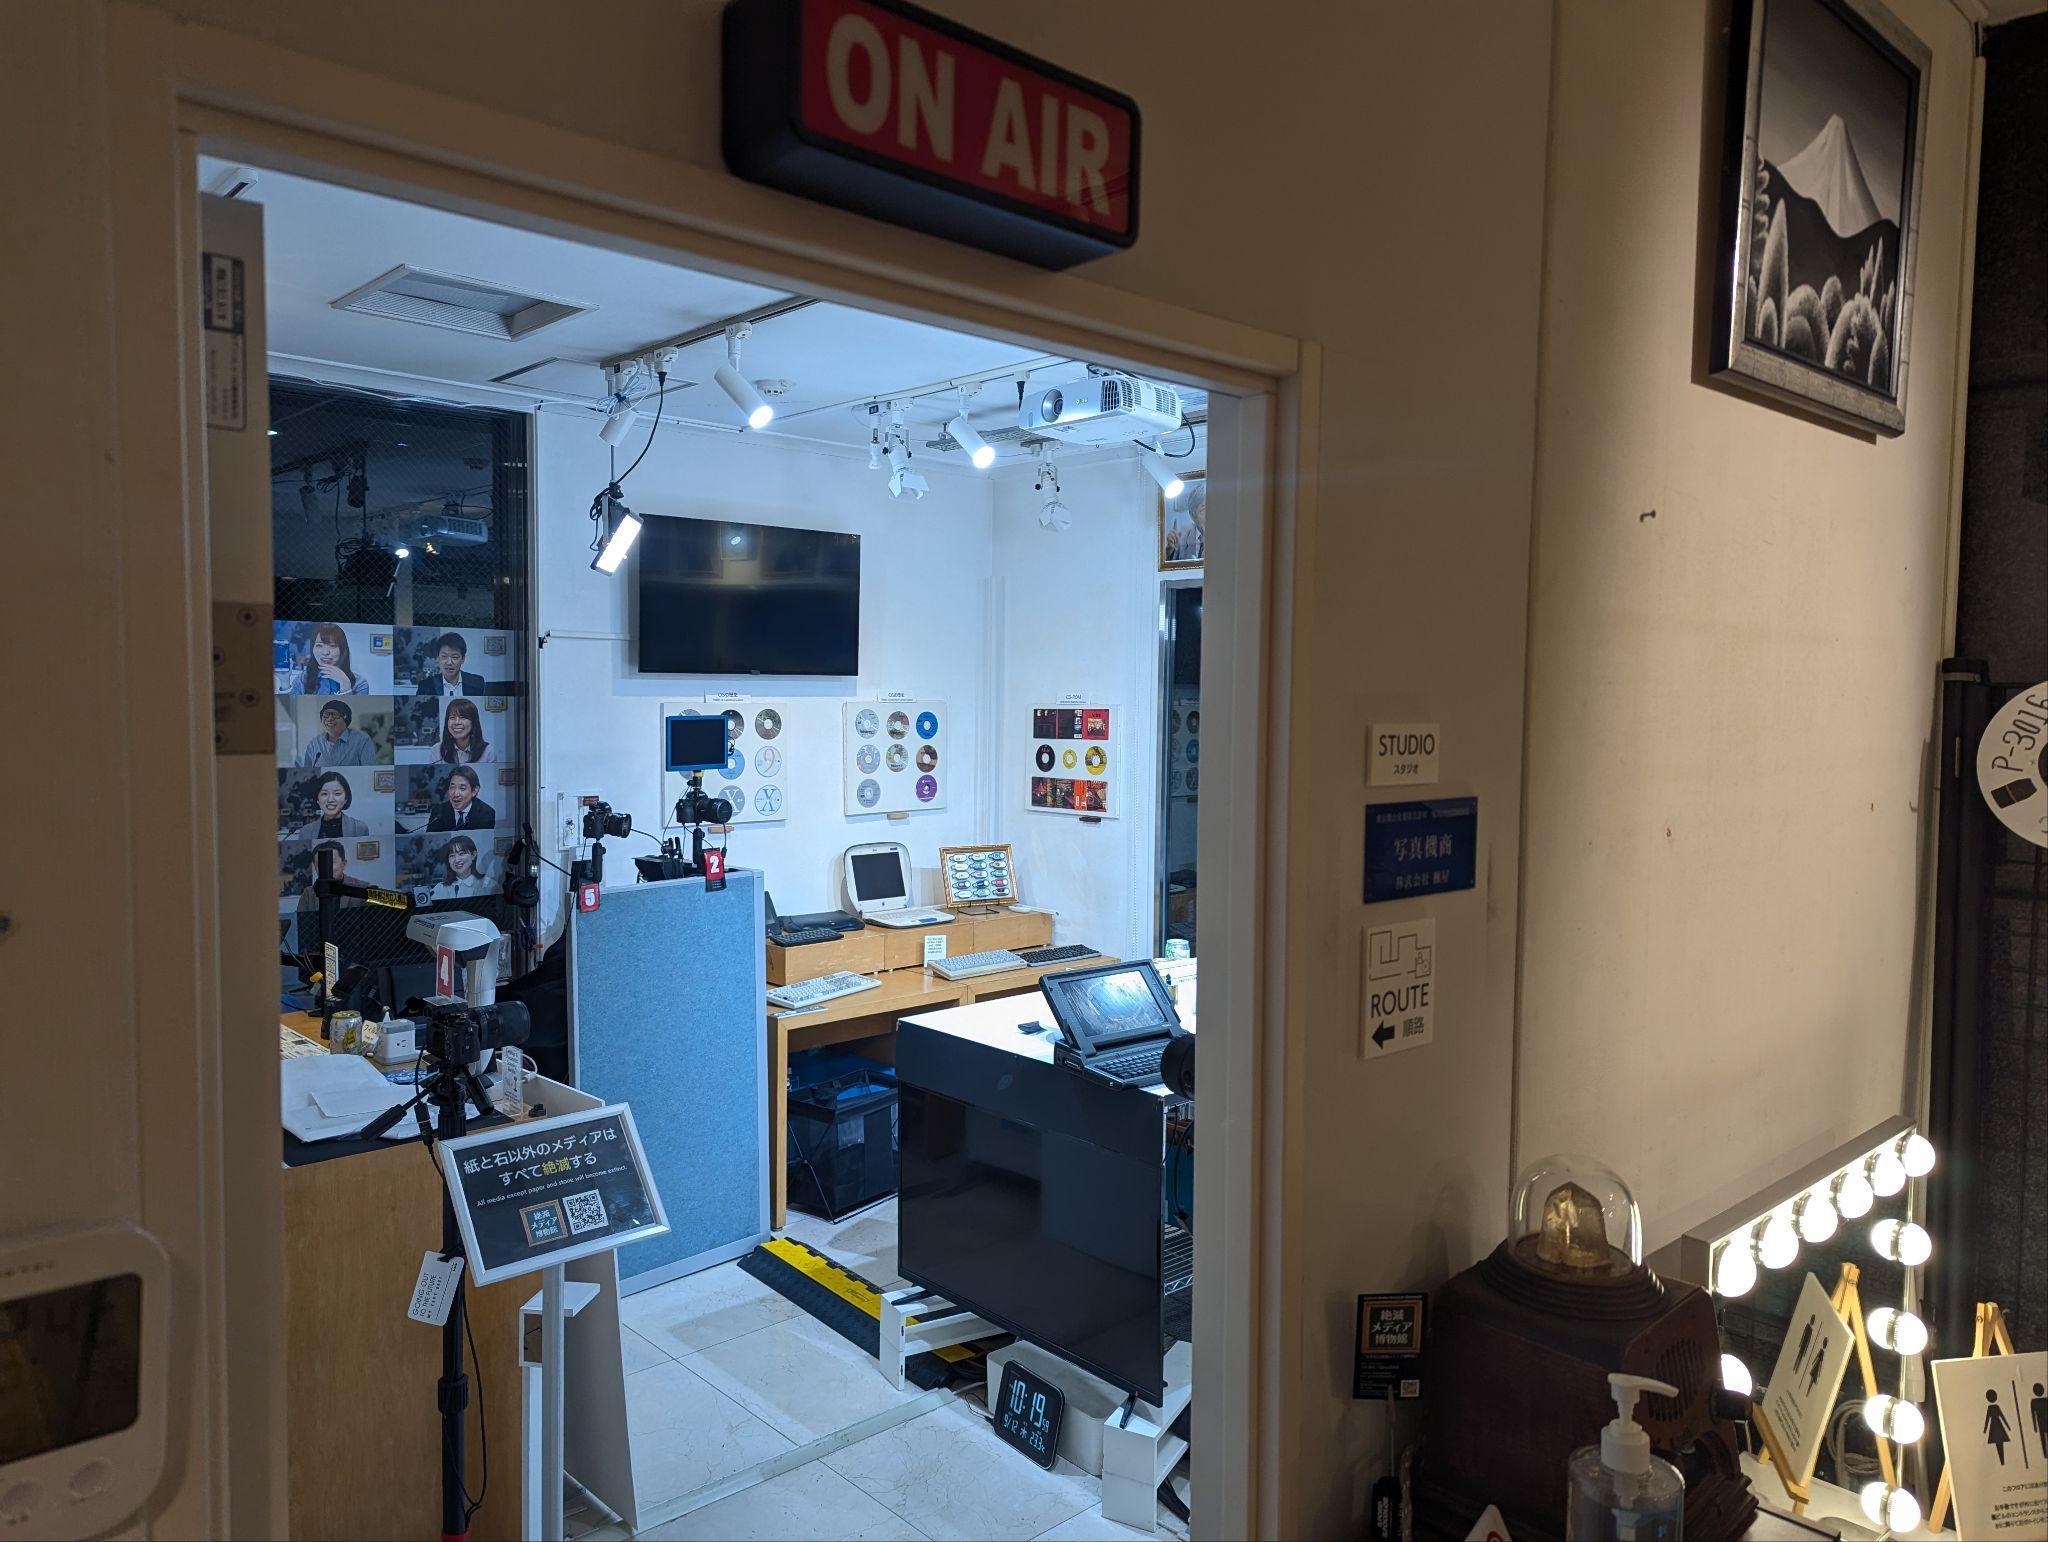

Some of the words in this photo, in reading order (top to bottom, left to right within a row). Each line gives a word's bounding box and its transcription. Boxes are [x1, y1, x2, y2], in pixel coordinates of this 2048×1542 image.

[826, 13, 956, 163] ON
[979, 76, 1111, 215] AIR
[1379, 733, 1435, 756] STUDIO
[1393, 763, 1419, 775] スタジオ
[760, 788, 777, 812] X
[1394, 833, 1454, 862] 写真機商
[709, 855, 720, 874] 2
[584, 888, 596, 907] 5
[440, 954, 450, 987] 4
[1371, 982, 1430, 1019] ROUTE
[1402, 1016, 1425, 1038] 順路
[463, 1127, 618, 1176] 紙と石以外のメディアは
[498, 1152, 598, 1187] すべて絶滅する
[476, 1199, 486, 1207] All
[487, 1194, 506, 1206] media
[506, 1188, 528, 1201] except
[528, 1184, 546, 1196] paper
[546, 1179, 557, 1189] and
[558, 1176, 575, 1187] stone
[575, 1171, 585, 1182] will
[585, 1168, 608, 1180] become
[530, 1216, 559, 1231] メディア
[412, 1289, 425, 1316] GOING
[420, 1272, 430, 1288] OUT
[426, 1274, 437, 1296] FUTURE
[420, 1308, 427, 1317] TO
[423, 1297, 431, 1308] THE
[1381, 1309, 1405, 1321] 絶滅
[1371, 1321, 1414, 1333] メディア
[1375, 1333, 1409, 1346] 博物館
[1010, 1380, 1046, 1428] 10:19
